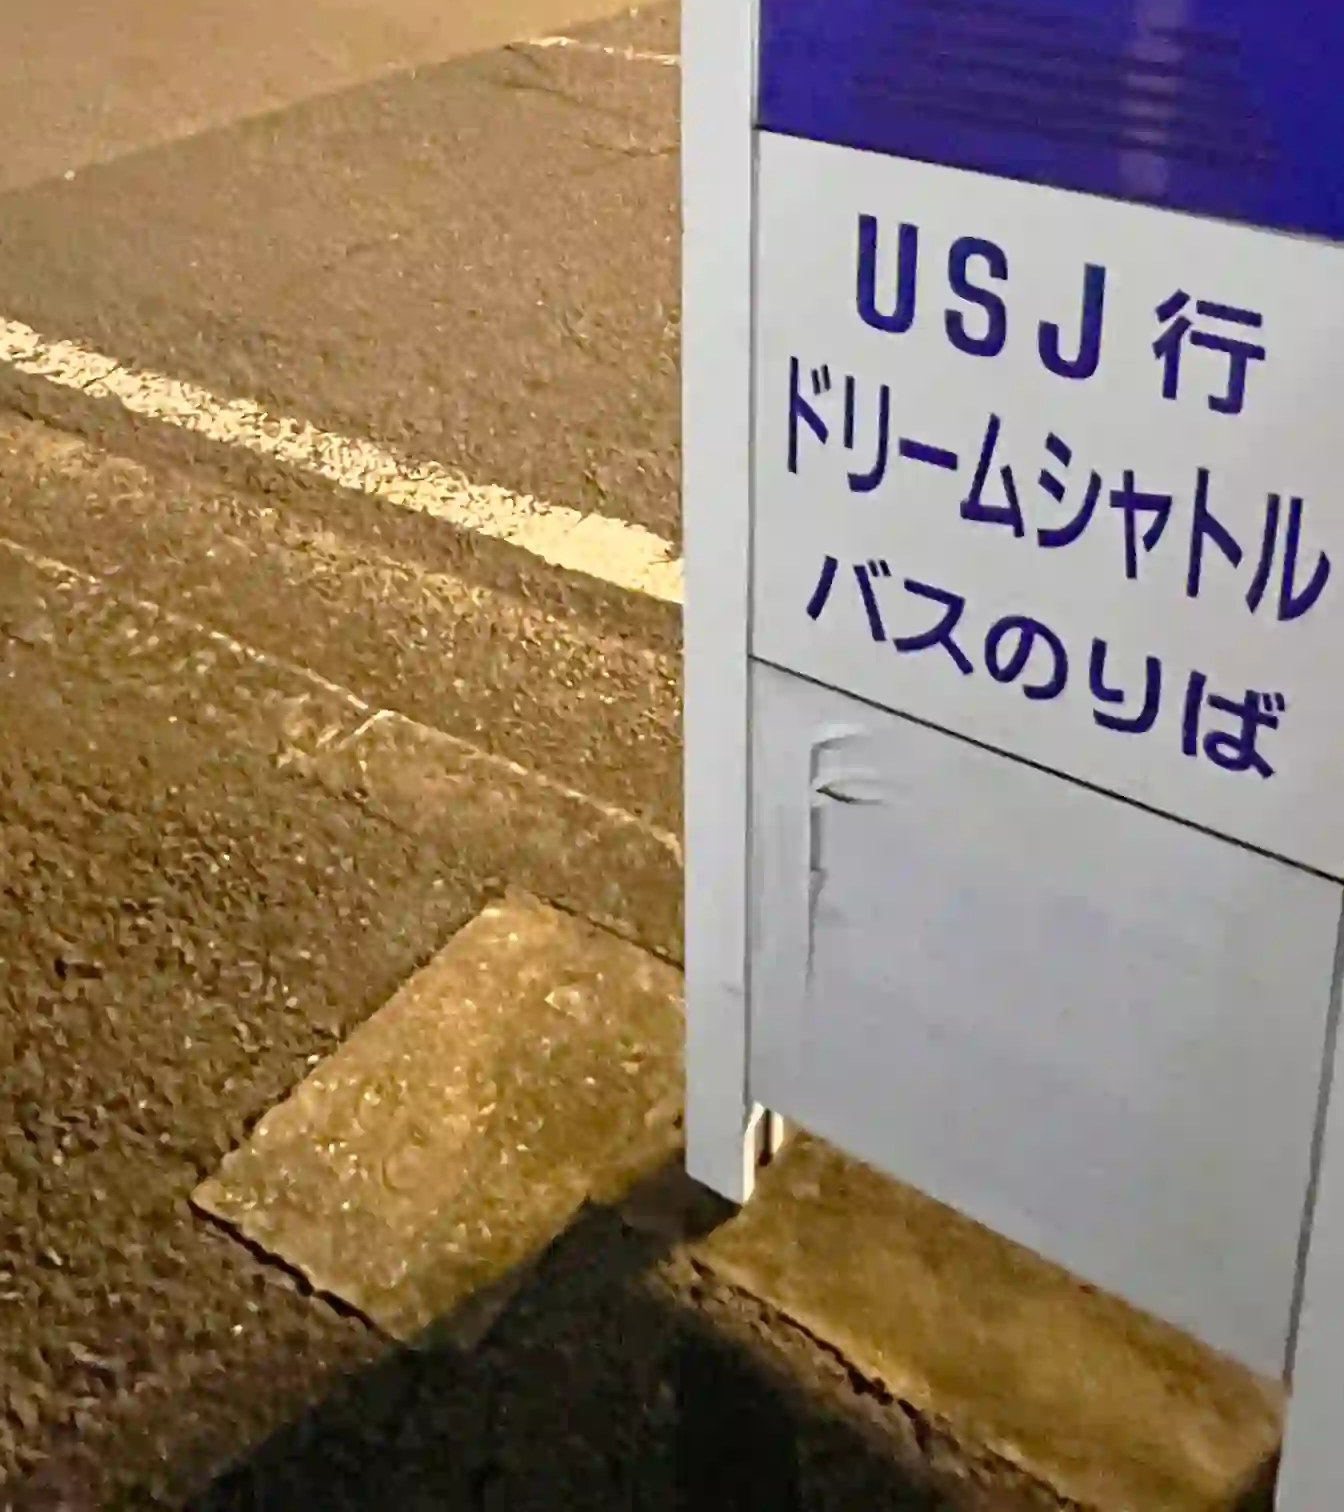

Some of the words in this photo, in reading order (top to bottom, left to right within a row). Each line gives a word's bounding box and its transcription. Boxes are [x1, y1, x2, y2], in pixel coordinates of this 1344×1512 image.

[787, 355, 1331, 621] ドリームシャトル
[807, 555, 1285, 778] バスのりば
